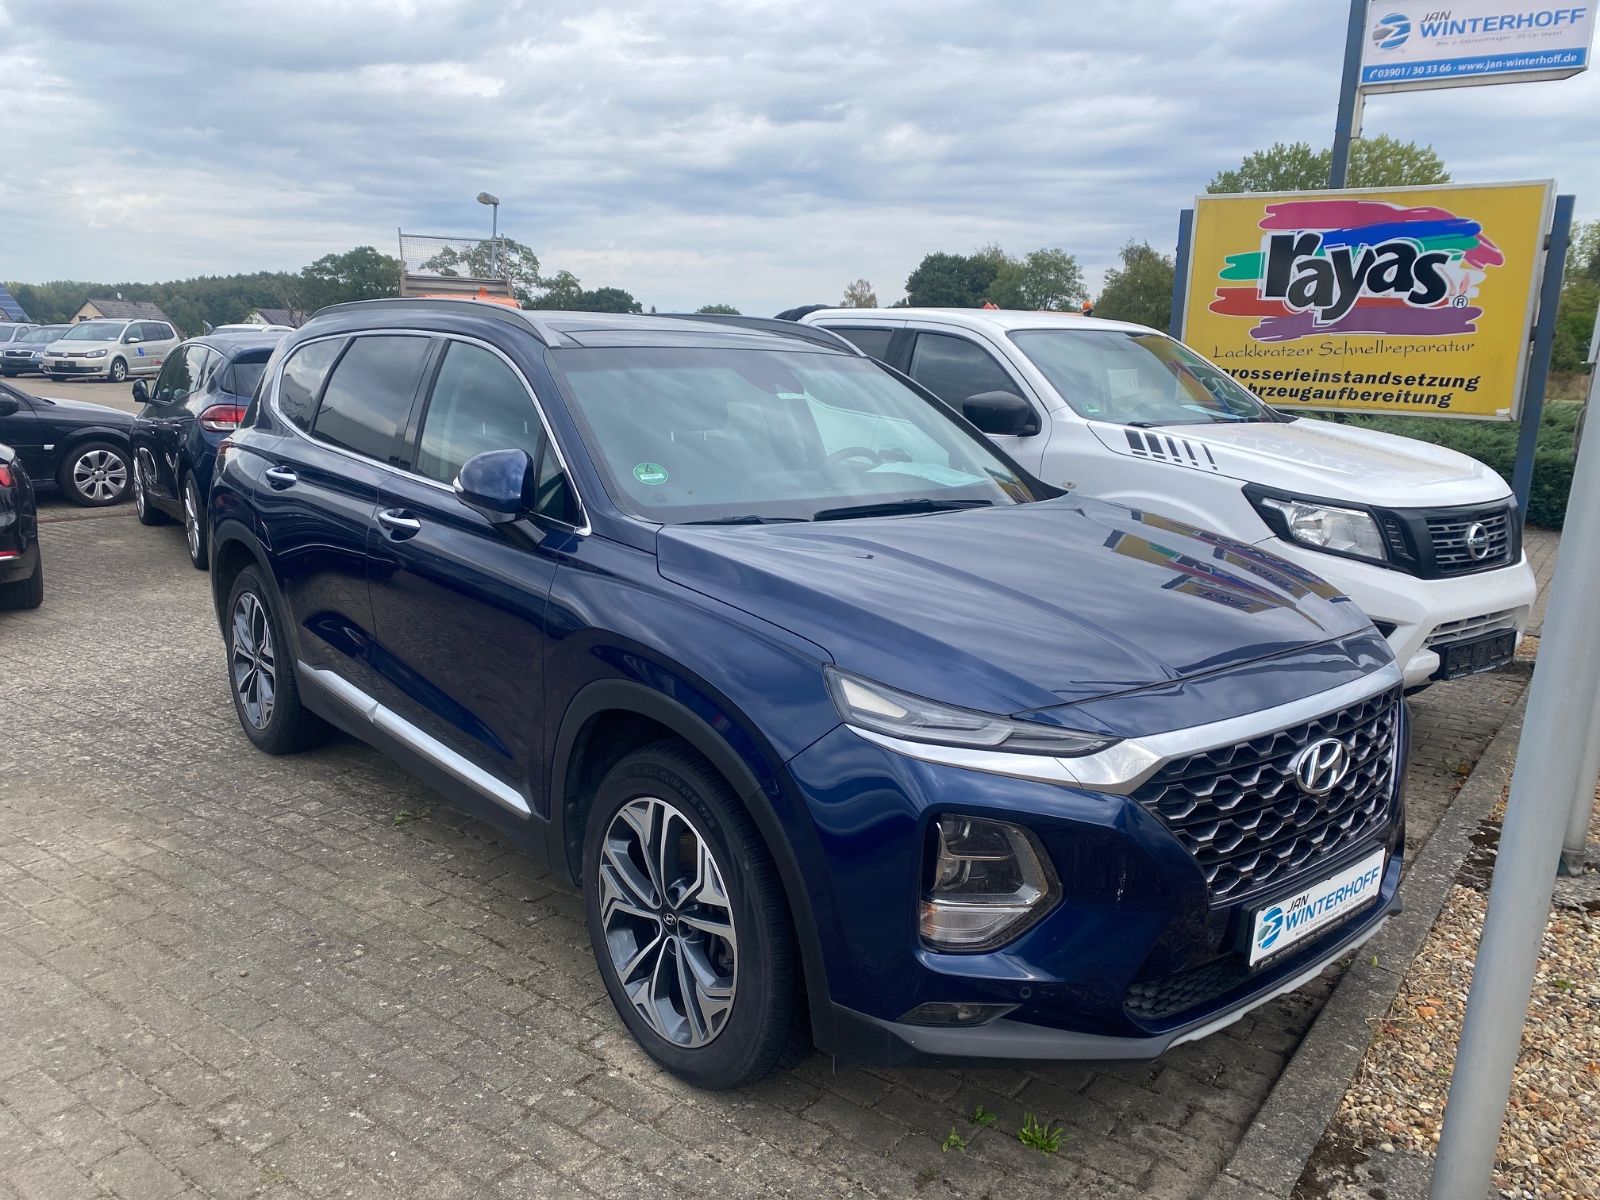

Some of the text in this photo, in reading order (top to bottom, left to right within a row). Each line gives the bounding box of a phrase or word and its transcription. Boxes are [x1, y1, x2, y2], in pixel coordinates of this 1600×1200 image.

[1420, 7, 1588, 38] WINTERHOFF
[1421, 10, 1452, 22] JAN
[1378, 67, 1405, 78] 03901
[1457, 53, 1578, 71] www.jan-winterhoff.de
[1264, 232, 1450, 321] rayas
[1212, 339, 1476, 358] Lackkratzer Schnellreparatur
[1217, 366, 1482, 392] rosserieinstandsetzung
[1247, 382, 1454, 409] hrzeugaufbereitung
[1286, 865, 1381, 932] WINTERHOFF
[1286, 893, 1310, 914] JAN
